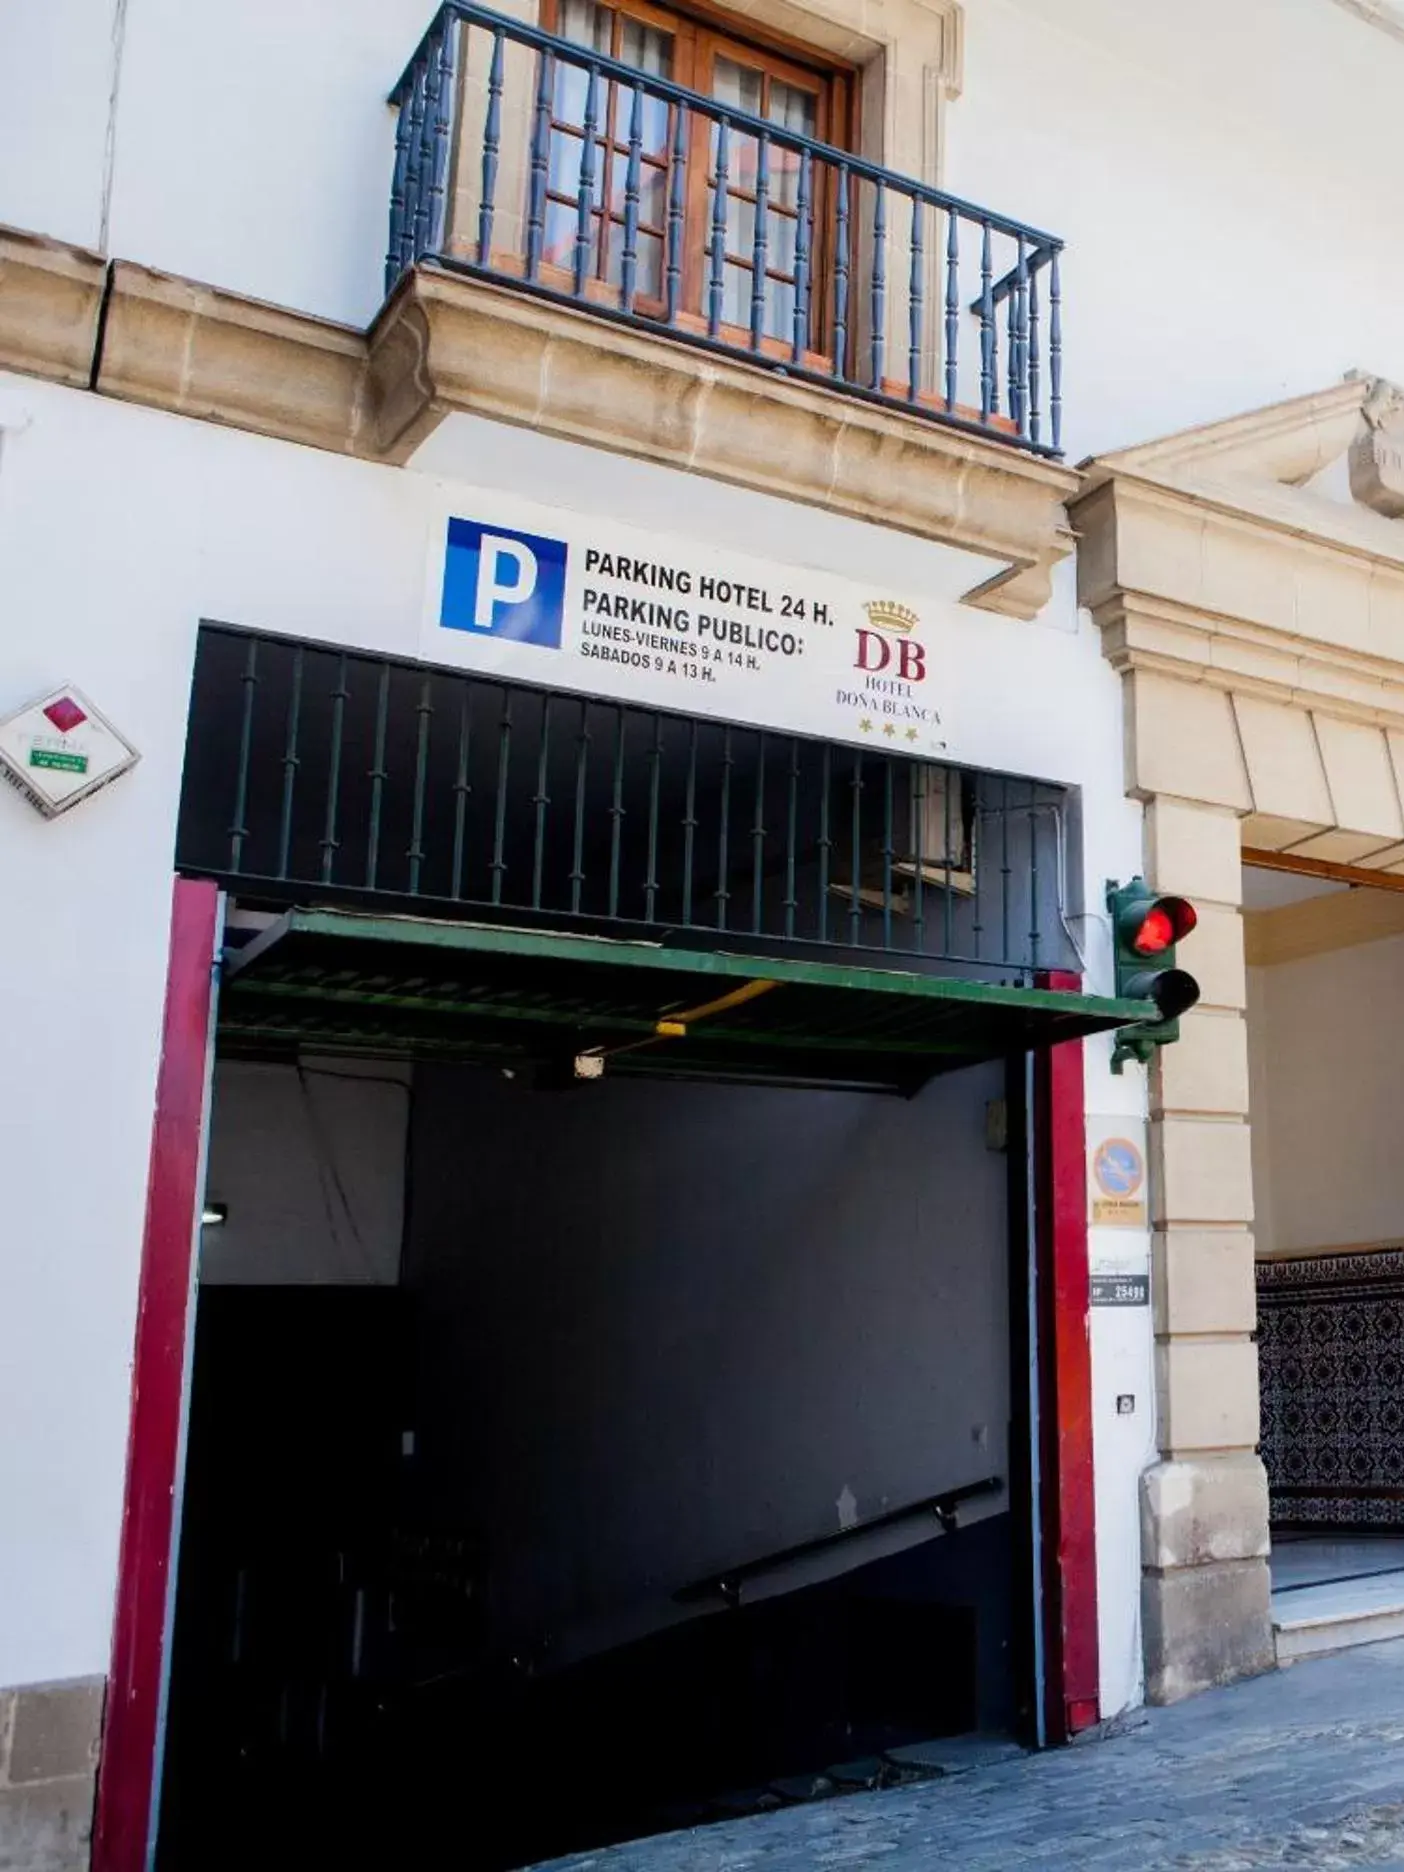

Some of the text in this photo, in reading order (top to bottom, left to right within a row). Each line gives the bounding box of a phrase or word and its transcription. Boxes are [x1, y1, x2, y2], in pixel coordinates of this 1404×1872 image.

[475, 533, 538, 628] P
[585, 549, 834, 626] PARKING HOTEL 24 H.
[582, 620, 760, 671] LUNES-VIERNES 9 A 14 H.
[583, 589, 803, 655] PARKING PUBLICO:
[581, 642, 716, 682] SABADOS 9 A 13 H.
[865, 676, 914, 699] HOTEL
[883, 702, 941, 725] BLANCA
